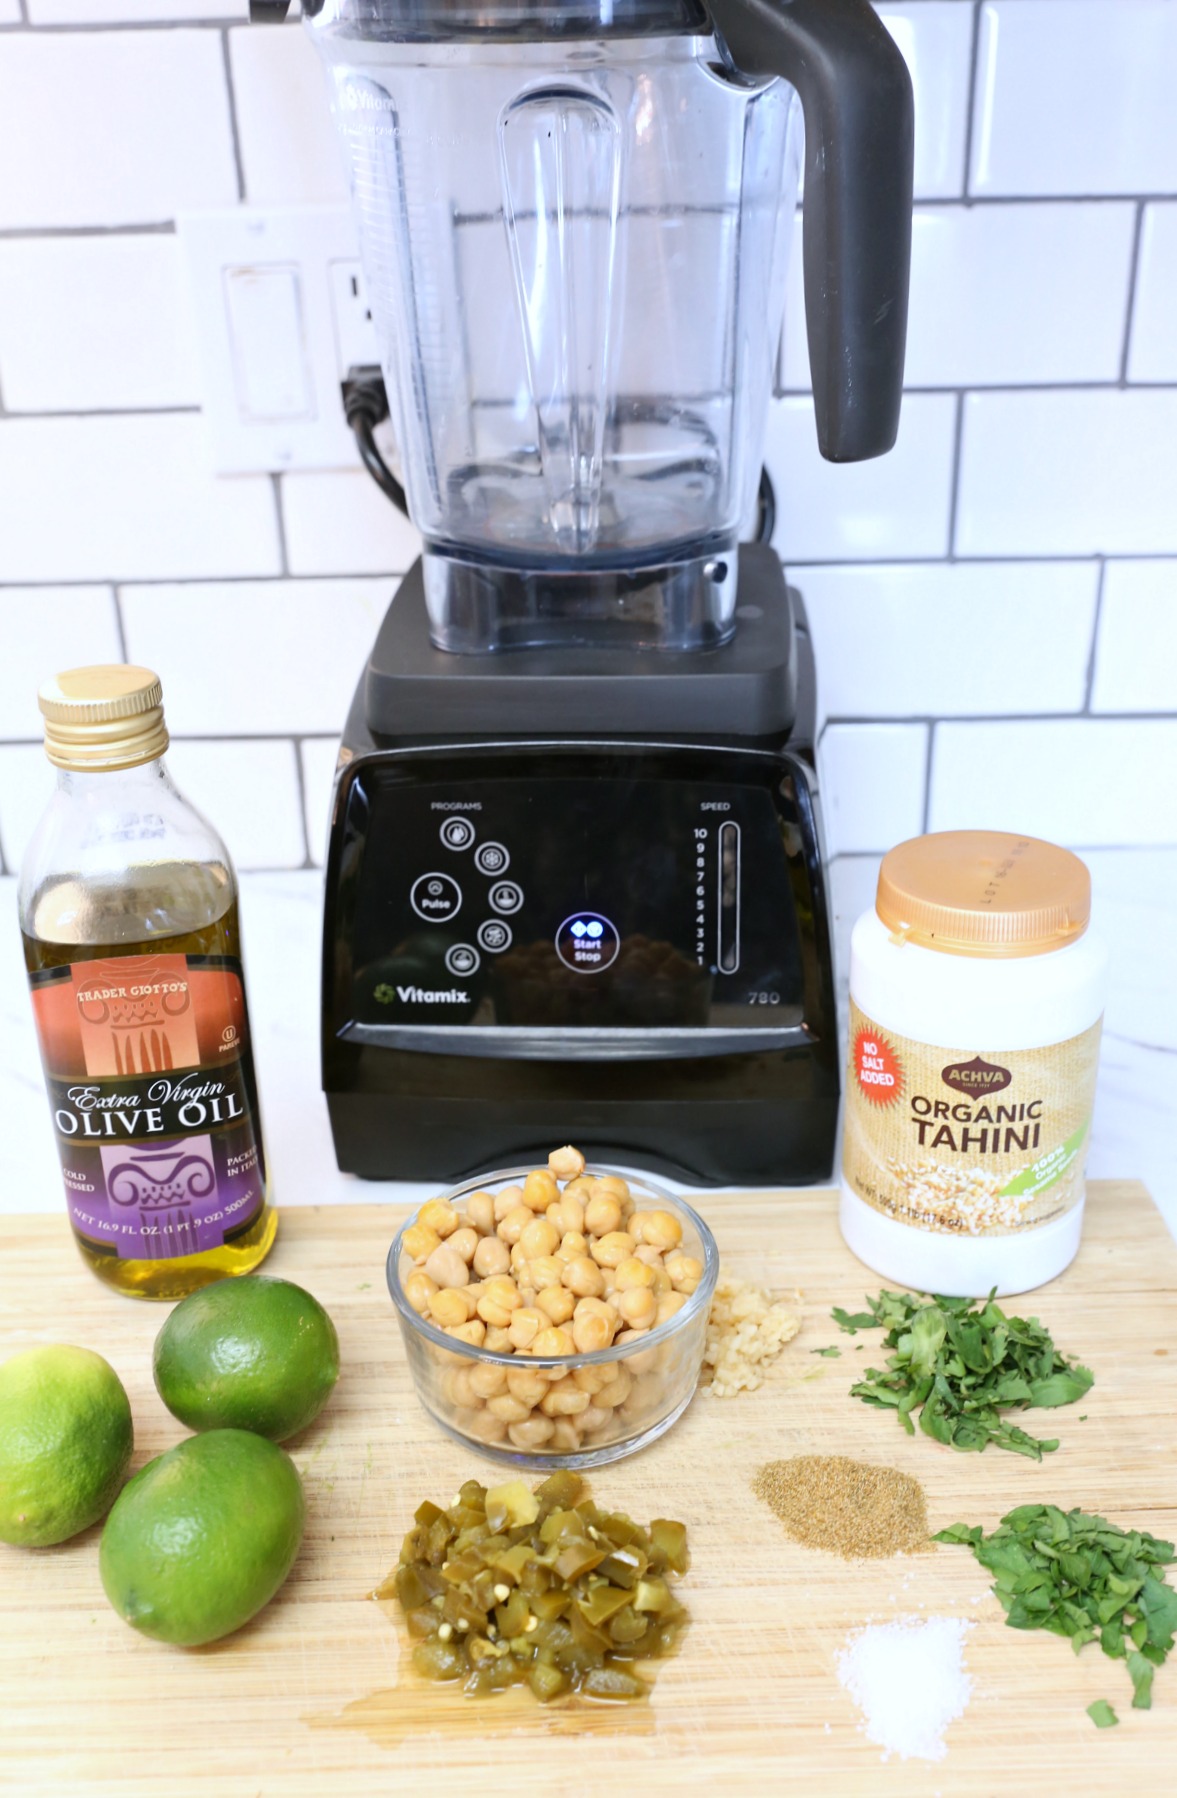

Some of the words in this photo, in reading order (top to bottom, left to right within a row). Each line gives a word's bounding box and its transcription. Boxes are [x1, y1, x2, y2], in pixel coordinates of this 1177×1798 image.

[430, 802, 482, 811] PROGRAMS
[700, 802, 731, 811] SPEED
[694, 828, 708, 839] 10
[696, 842, 705, 853] 9
[696, 857, 705, 868] 8
[696, 872, 705, 882] 7
[696, 886, 705, 896] 6
[422, 899, 451, 909] Pulse
[696, 900, 705, 910] 5
[696, 914, 705, 924] 4
[696, 928, 705, 938] 3
[573, 938, 602, 949] Start
[696, 942, 705, 952] 2
[574, 951, 602, 963] Stop
[697, 956, 703, 966] 1
[77, 987, 127, 1002] TRADER
[130, 982, 188, 996] GIOTTO'S
[396, 985, 467, 1003] Vitamix
[749, 991, 781, 1004] 780
[863, 1041, 878, 1056] NO
[862, 1055, 884, 1070] SALT
[860, 1069, 894, 1086] ADDED
[948, 1069, 1005, 1083] ACHVA
[67, 1086, 141, 1111] Extra
[147, 1072, 225, 1110] Virgin
[55, 1107, 164, 1136] OLIVE
[178, 1093, 243, 1127] OIL
[911, 1095, 1043, 1124] ORGANIC
[911, 1117, 1041, 1154] TAHINI
[1031, 1144, 1065, 1172] 100%
[227, 1167, 239, 1177] IN
[73, 1207, 96, 1225] NET
[98, 1220, 119, 1232] 16.9
[163, 1225, 174, 1235] (1
[177, 1222, 190, 1233] PT
[204, 1211, 224, 1225] OZ)
